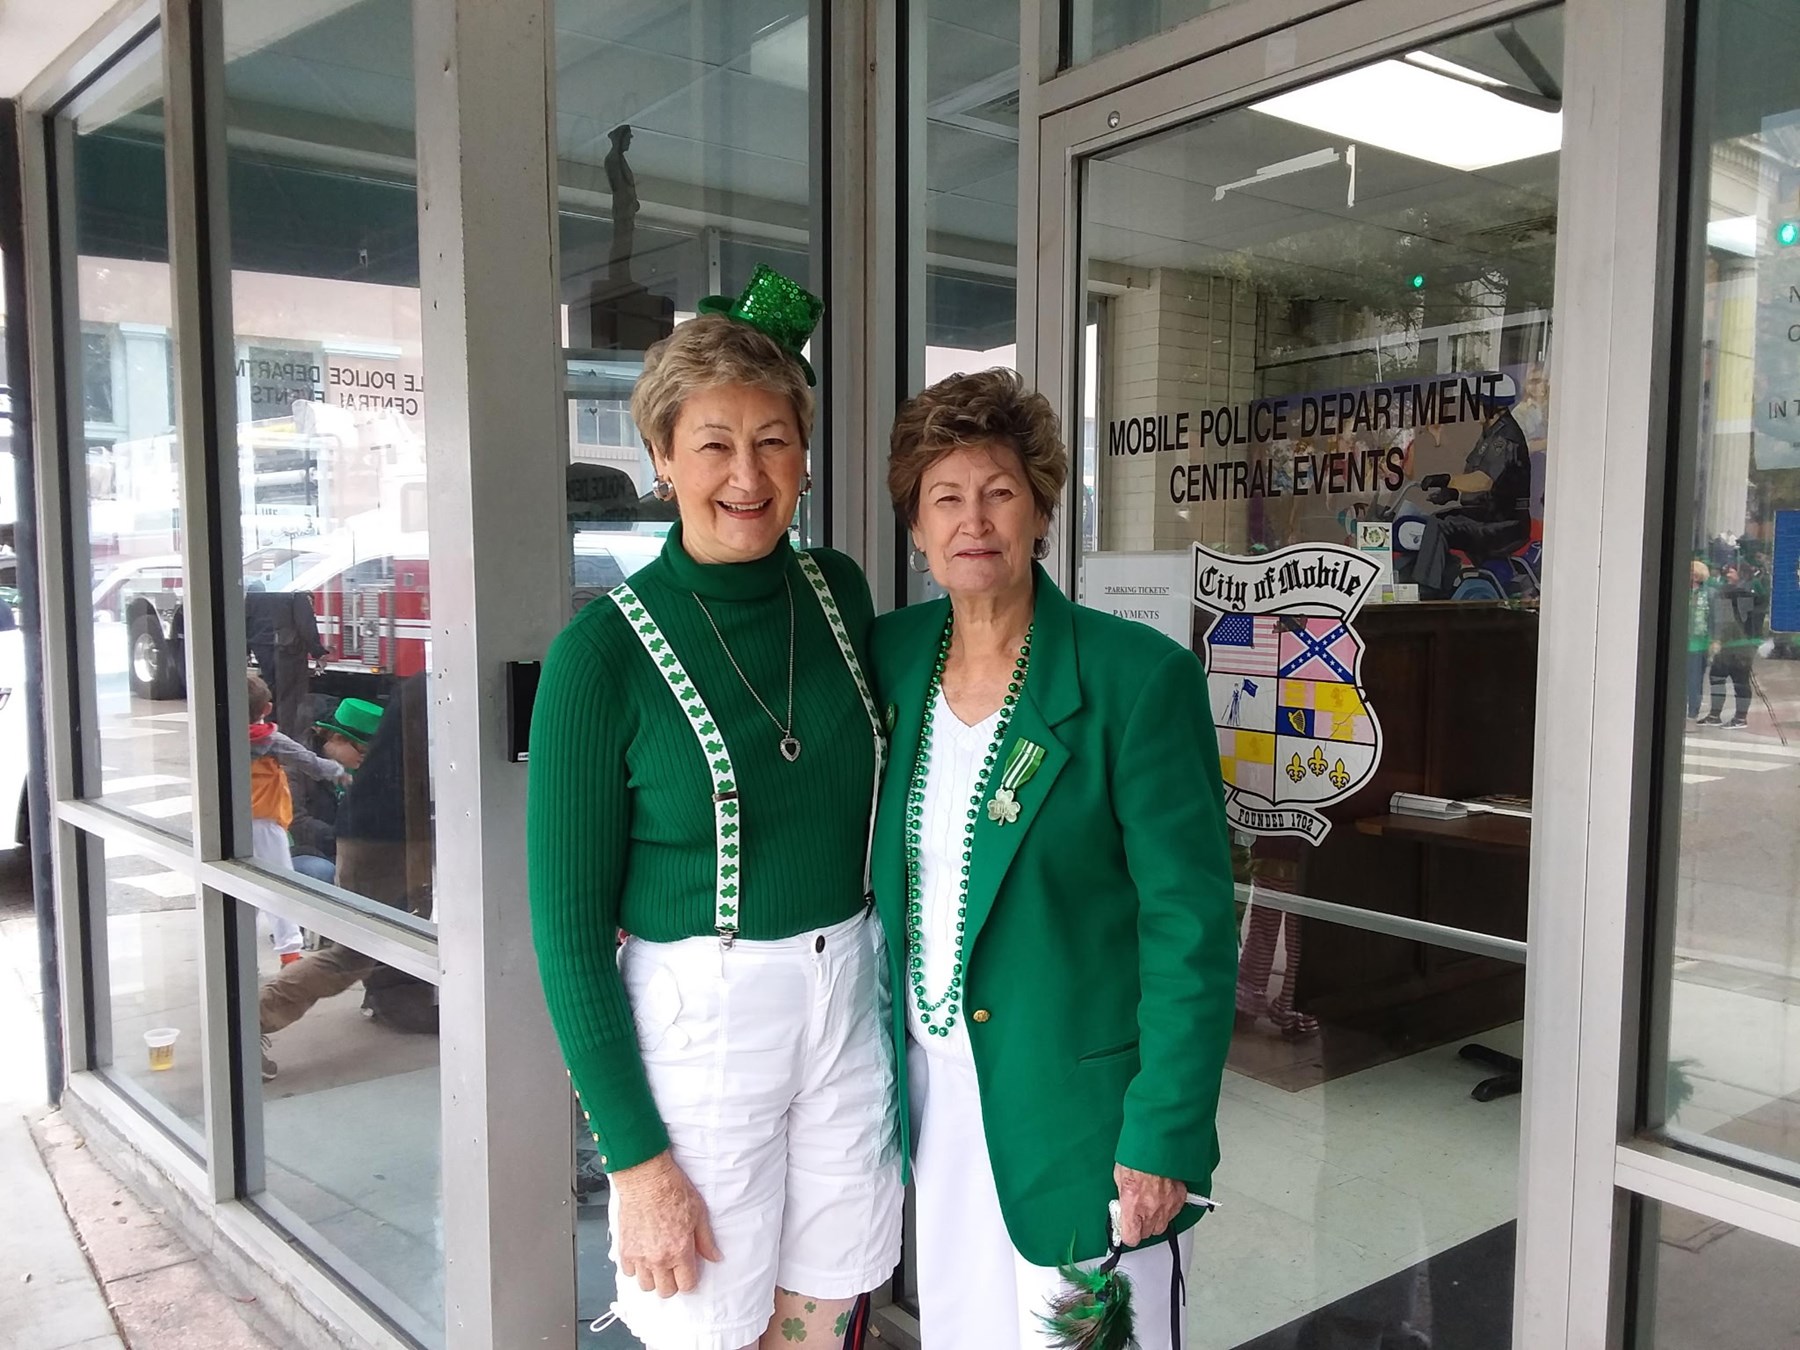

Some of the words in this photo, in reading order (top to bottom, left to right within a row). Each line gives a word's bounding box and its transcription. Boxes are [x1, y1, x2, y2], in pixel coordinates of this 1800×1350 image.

[1109, 412, 1189, 456] MOBILE
[1200, 400, 1288, 448] POLICE
[1301, 373, 1503, 438] DEPARTMENT
[1170, 459, 1281, 504] CENTRAL
[1293, 446, 1404, 496] EVENTS
[1200, 565, 1248, 611] City
[1254, 567, 1276, 603] of
[1278, 555, 1362, 598] Mobile
[1113, 609, 1160, 620] PAYMENTS
[1238, 808, 1285, 828] FOUNDED
[1291, 813, 1314, 832] 1702
